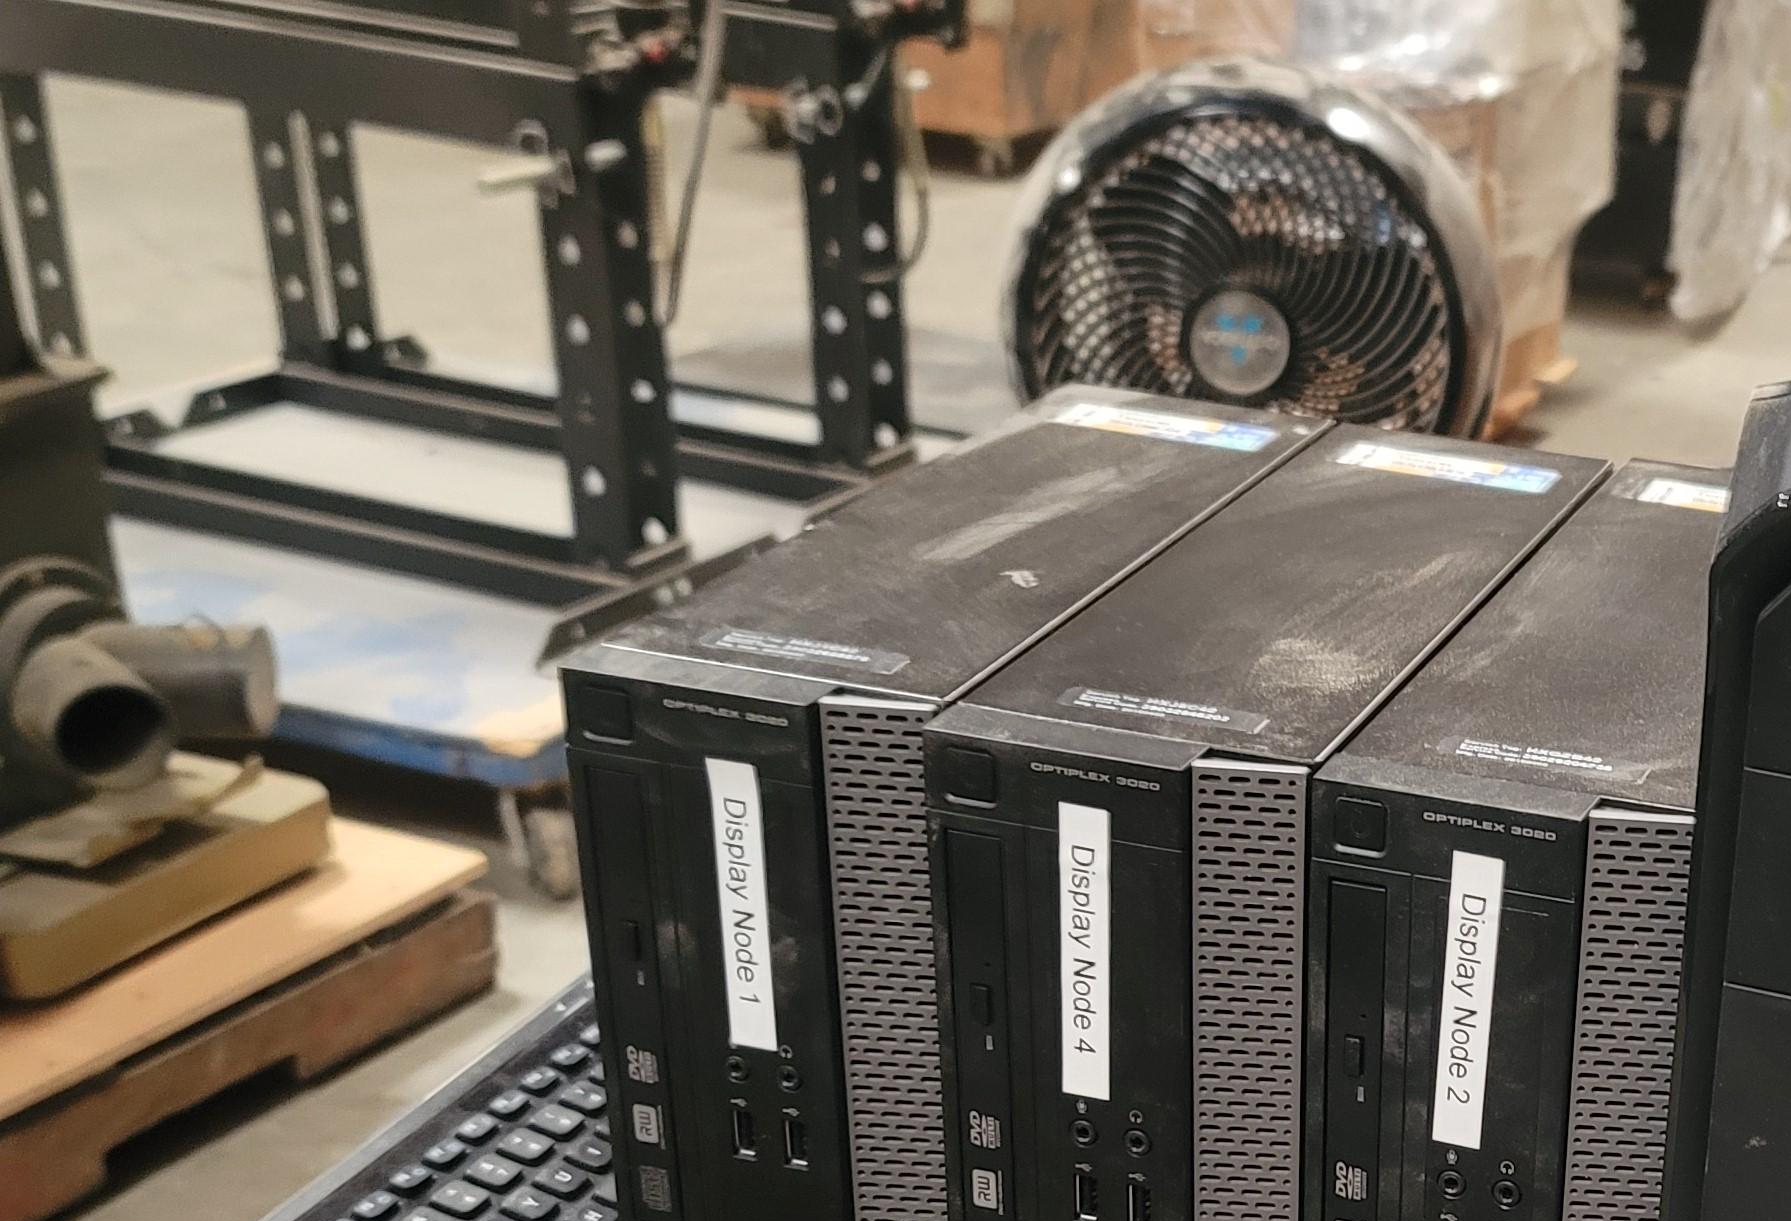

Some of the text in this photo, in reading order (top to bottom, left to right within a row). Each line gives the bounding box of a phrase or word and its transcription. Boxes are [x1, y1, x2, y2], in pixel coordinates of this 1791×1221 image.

[663, 698, 741, 719] OPTIPLEX
[1030, 761, 1161, 791] OPTIPLEX 3020
[1422, 811, 1557, 841] OPTIPLEX 3020
[721, 797, 760, 1005] Display Node 1
[1067, 846, 1097, 1055] Display Node 4
[1446, 892, 1487, 1105] Display Node 2
[626, 1044, 641, 1081] DVD
[639, 1111, 653, 1136] RW
[969, 1109, 981, 1147] DVD
[977, 1175, 991, 1202] RW
[1335, 1160, 1347, 1199] DVD
